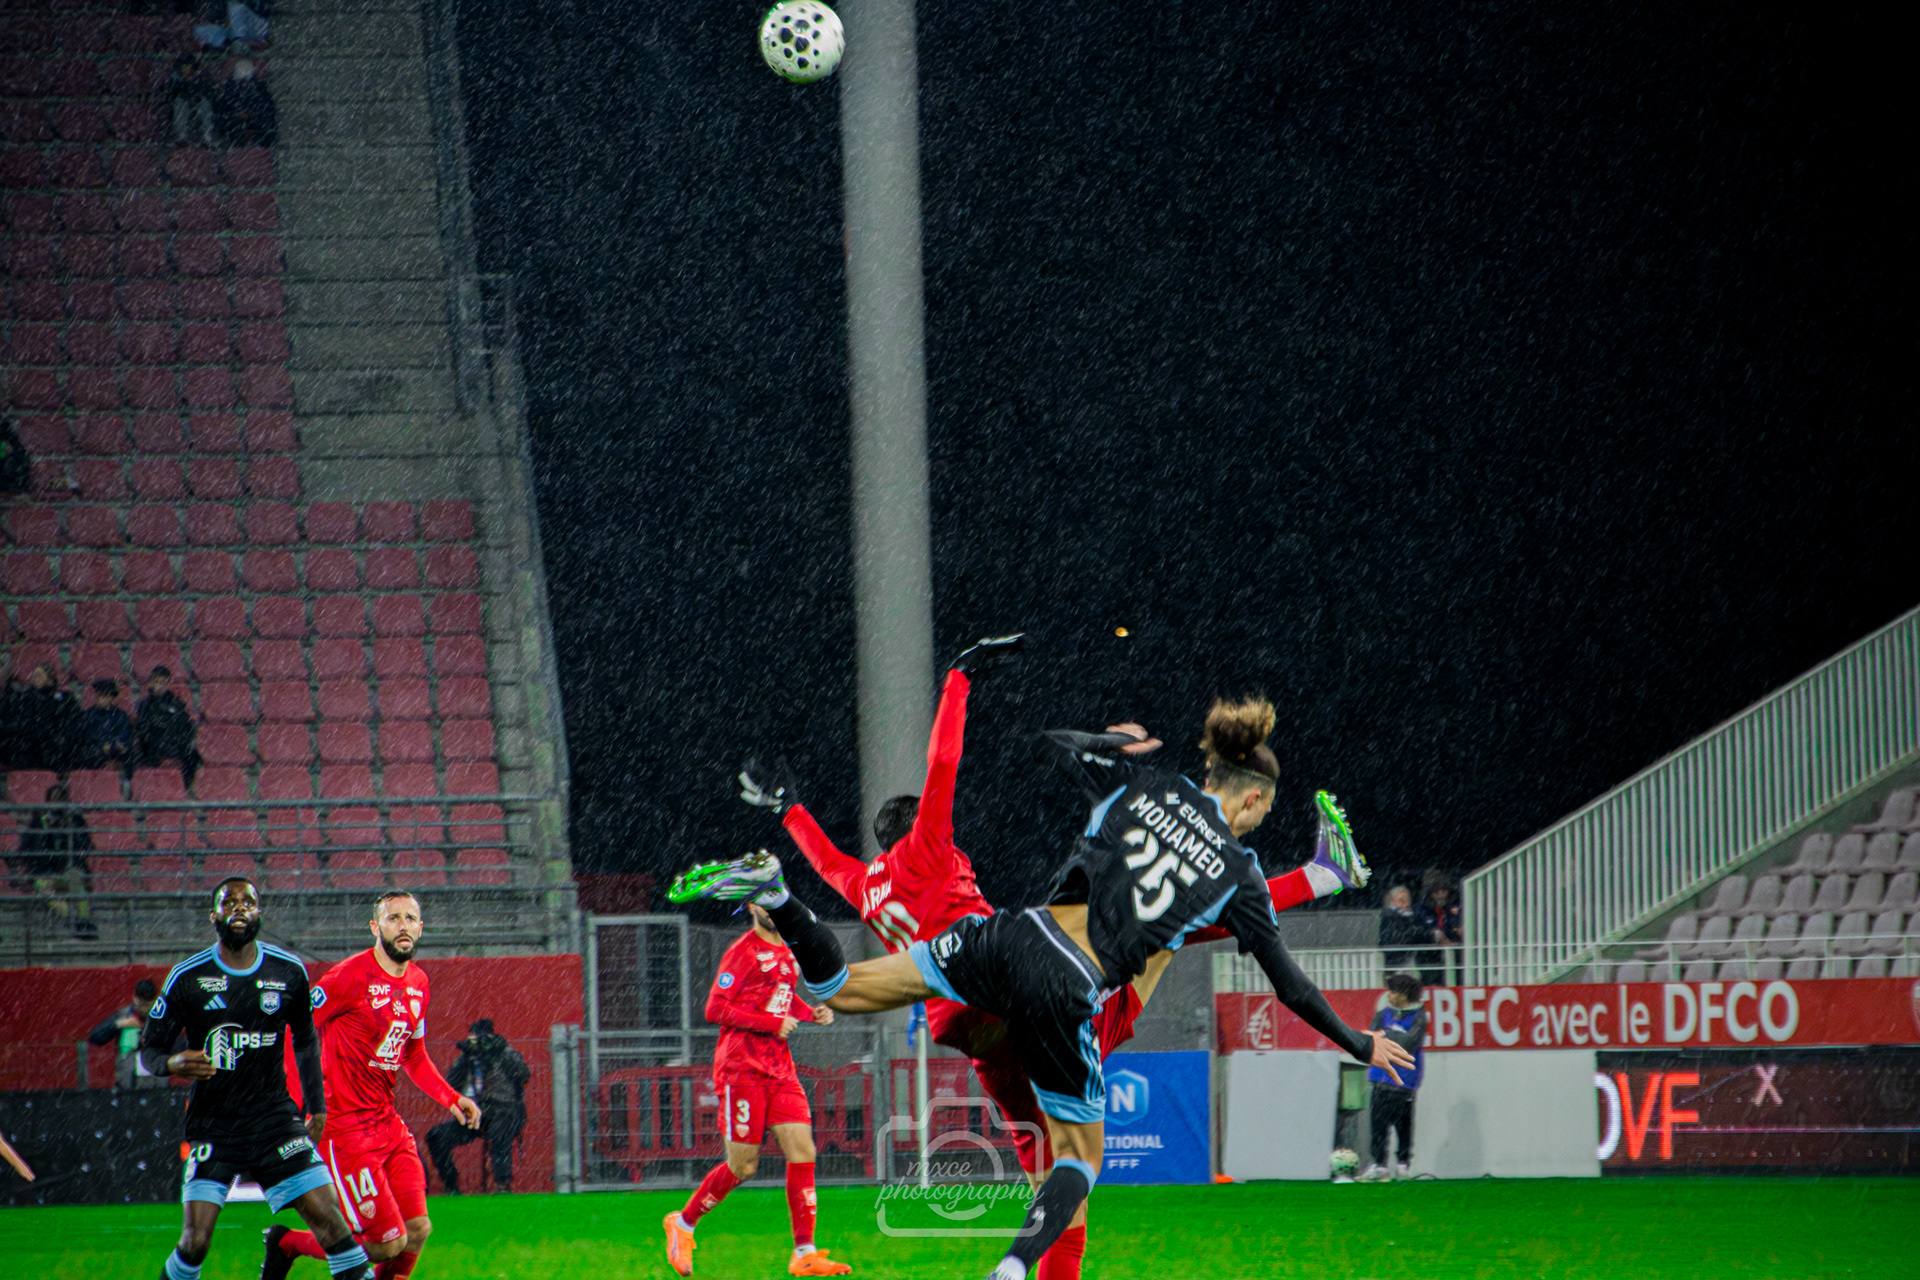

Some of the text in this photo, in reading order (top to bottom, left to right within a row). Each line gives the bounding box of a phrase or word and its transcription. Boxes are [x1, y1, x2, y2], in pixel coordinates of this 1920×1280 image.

[1129, 793, 1225, 880] MOHAMED
[1179, 802, 1226, 851] EUREX
[1124, 828, 1199, 922] 25
[368, 985, 391, 995] DVF
[1377, 980, 1799, 1047] BFC avec le DFCO
[233, 1033, 261, 1049] IPS
[737, 1099, 750, 1123] 3
[1110, 1083, 1136, 1113] N
[1103, 1135, 1164, 1149] TIONAL
[345, 1167, 378, 1203] 14
